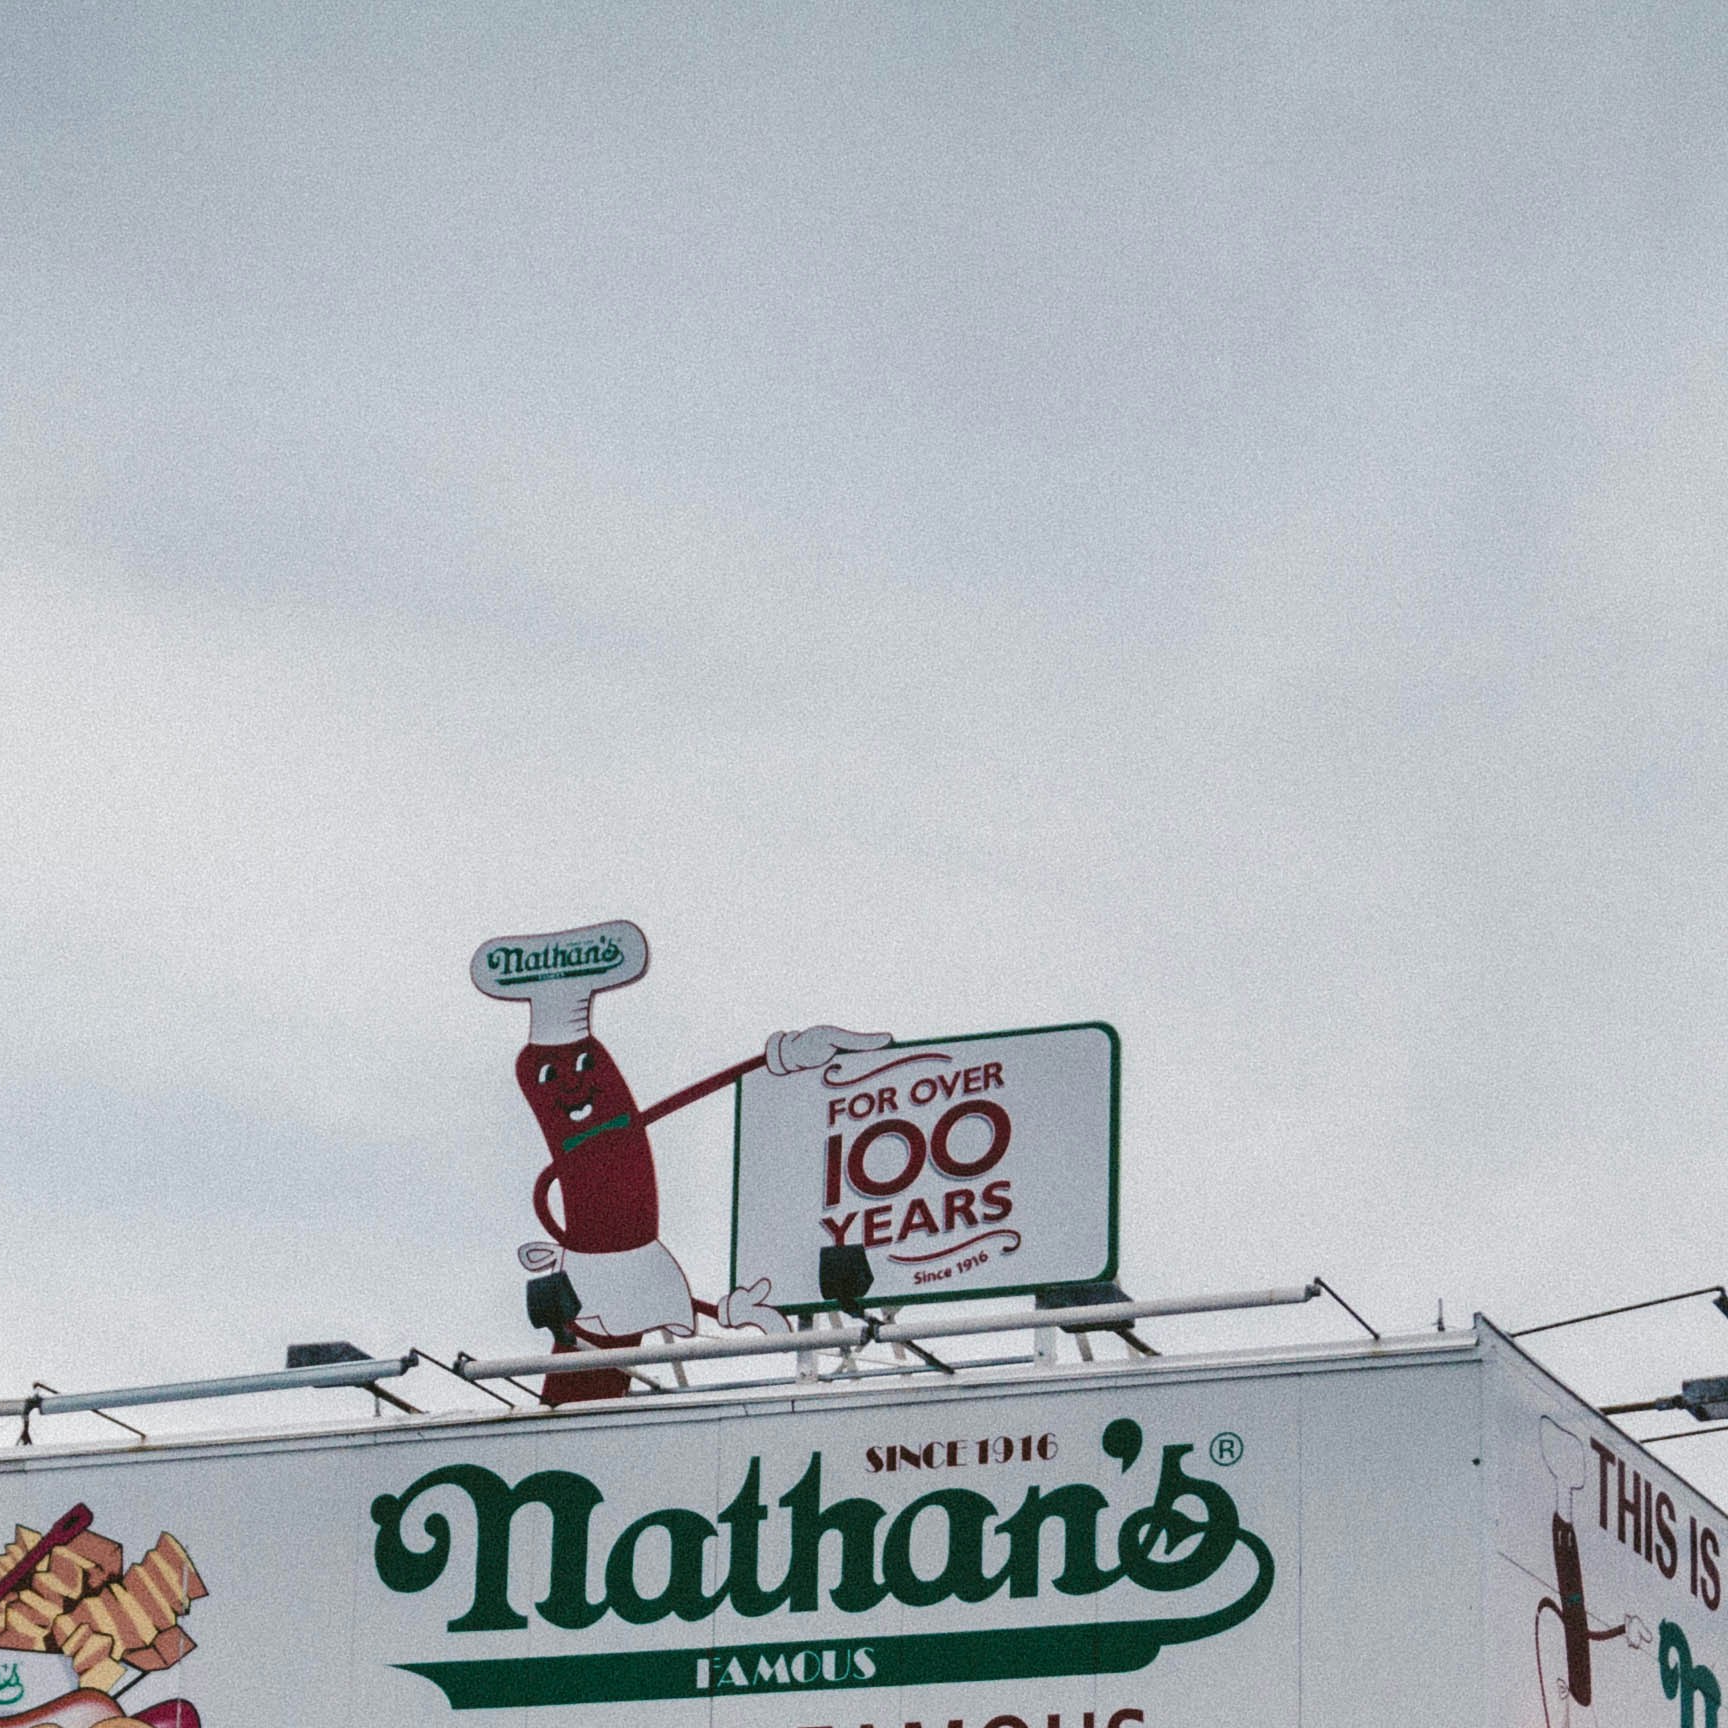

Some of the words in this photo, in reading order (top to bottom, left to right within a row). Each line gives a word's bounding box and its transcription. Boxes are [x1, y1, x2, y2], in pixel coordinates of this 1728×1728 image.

[828, 1084, 898, 1127] FOR
[909, 1059, 1005, 1107] OVER
[823, 1097, 1013, 1209] 100
[820, 1180, 1015, 1250] YEARS
[912, 1262, 952, 1287] Since
[954, 1249, 990, 1276] 1916
[865, 1437, 968, 1475] SINCE
[971, 1431, 1060, 1468] 1916
[369, 1416, 1241, 1634] Nathan's
[1589, 1435, 1678, 1580] THIS
[1688, 1515, 1722, 1612] IS
[695, 1645, 877, 1692] FAMOUS
